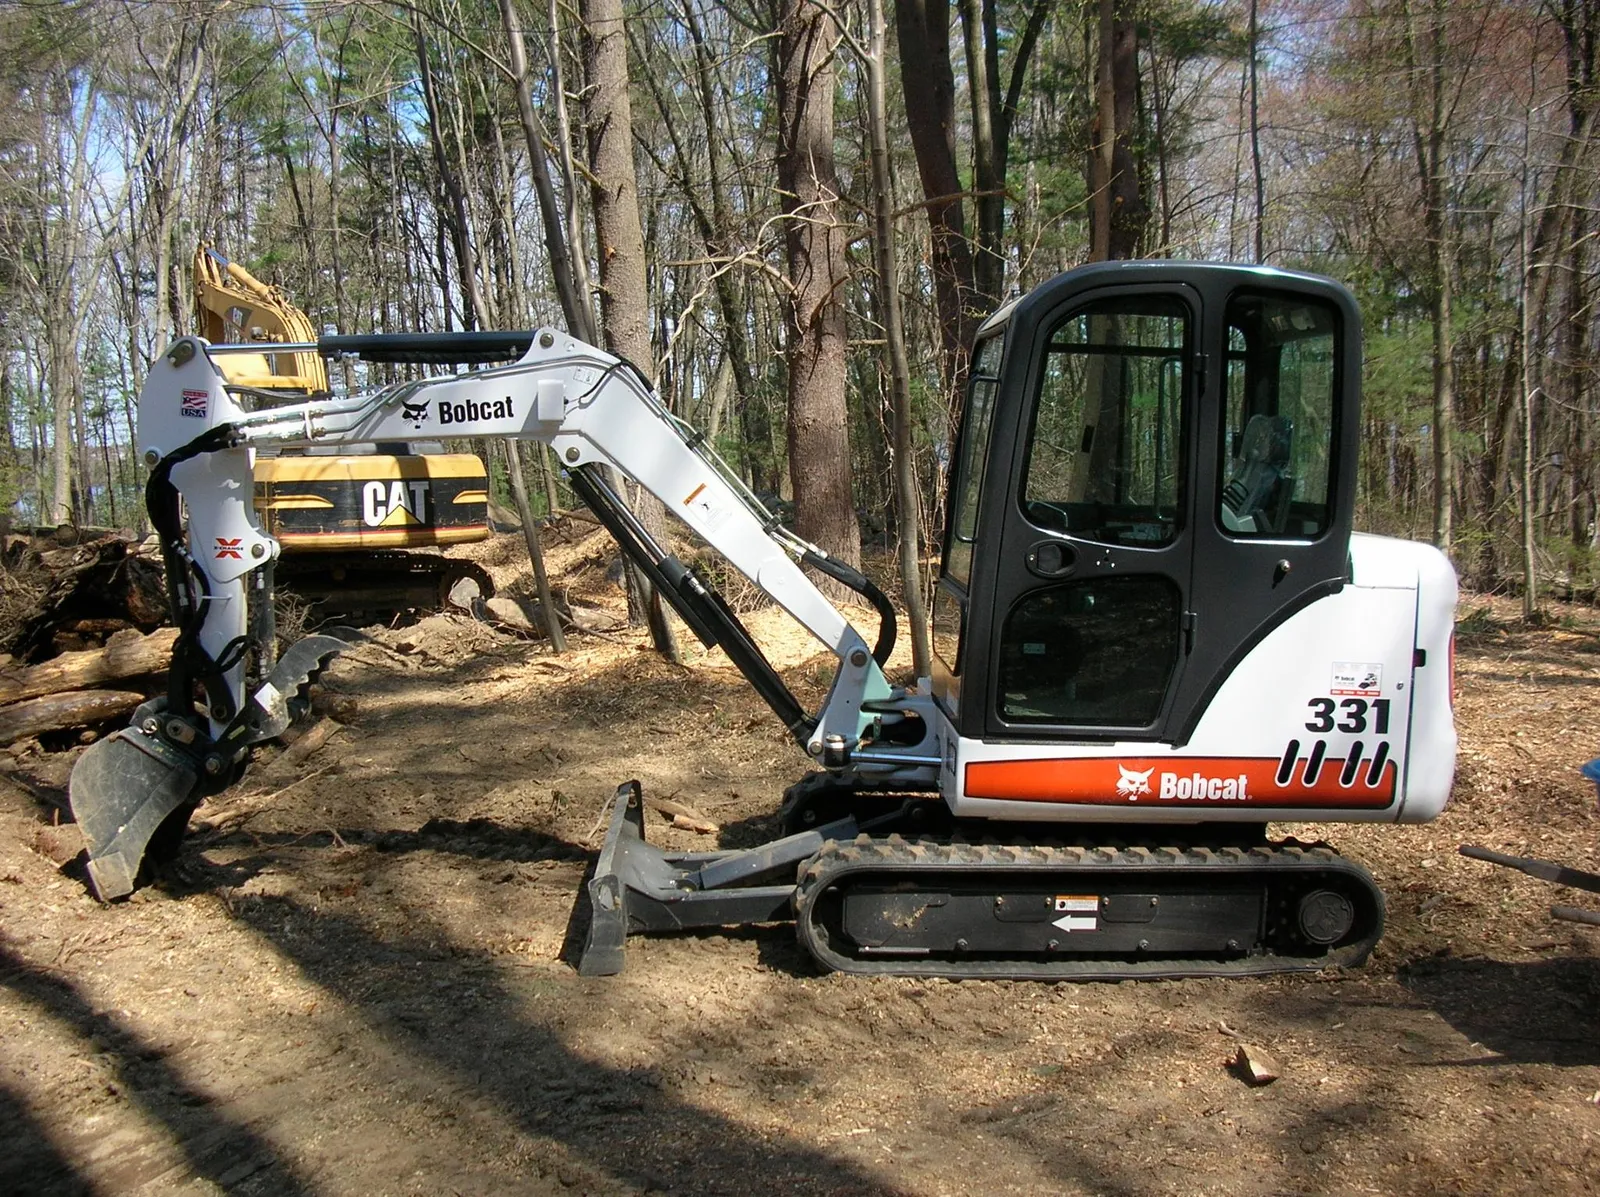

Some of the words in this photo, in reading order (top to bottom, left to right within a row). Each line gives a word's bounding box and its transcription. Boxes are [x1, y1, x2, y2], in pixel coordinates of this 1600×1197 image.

[181, 408, 207, 418] USA
[438, 396, 515, 425] Bobcat
[362, 480, 430, 527] CAT
[1304, 697, 1391, 735] 331
[1159, 772, 1249, 800] Bobcat
